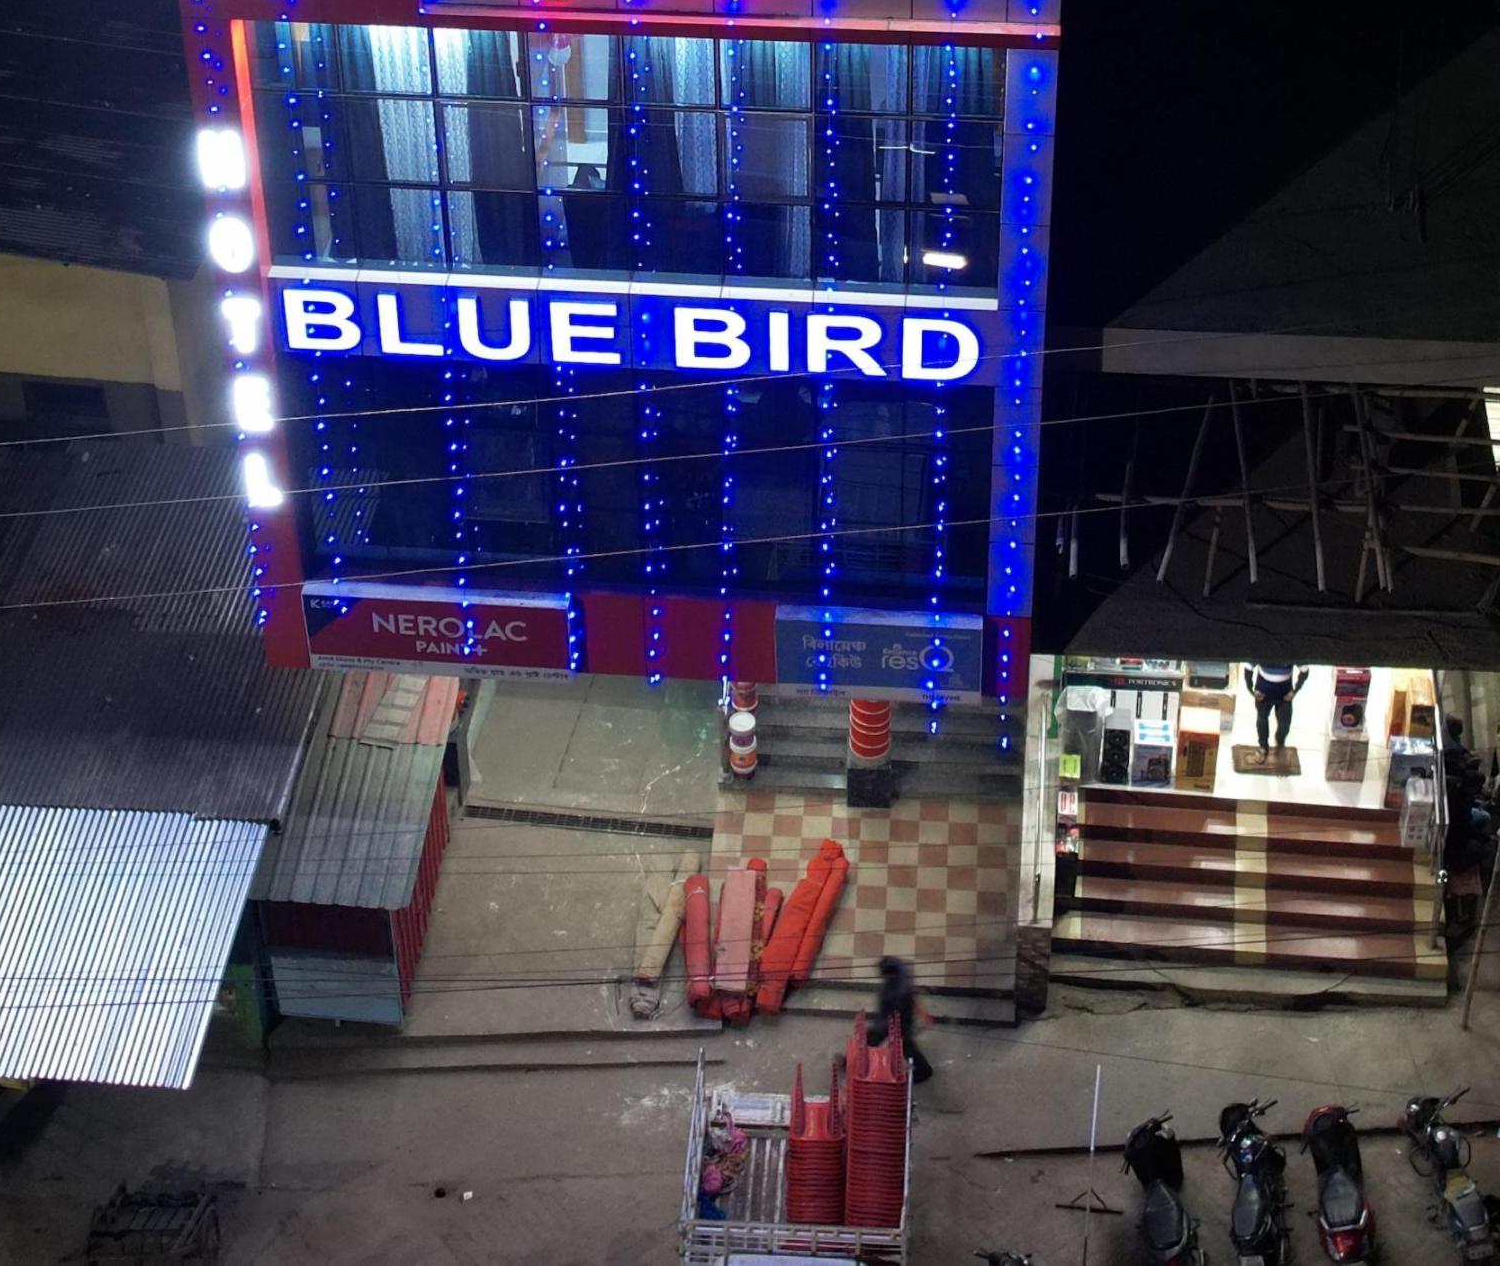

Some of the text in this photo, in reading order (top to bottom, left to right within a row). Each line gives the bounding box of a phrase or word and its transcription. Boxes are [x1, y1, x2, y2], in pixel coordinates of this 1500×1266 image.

[282, 288, 980, 380] BLUE BIRD
[371, 612, 528, 642] NEROLAC
